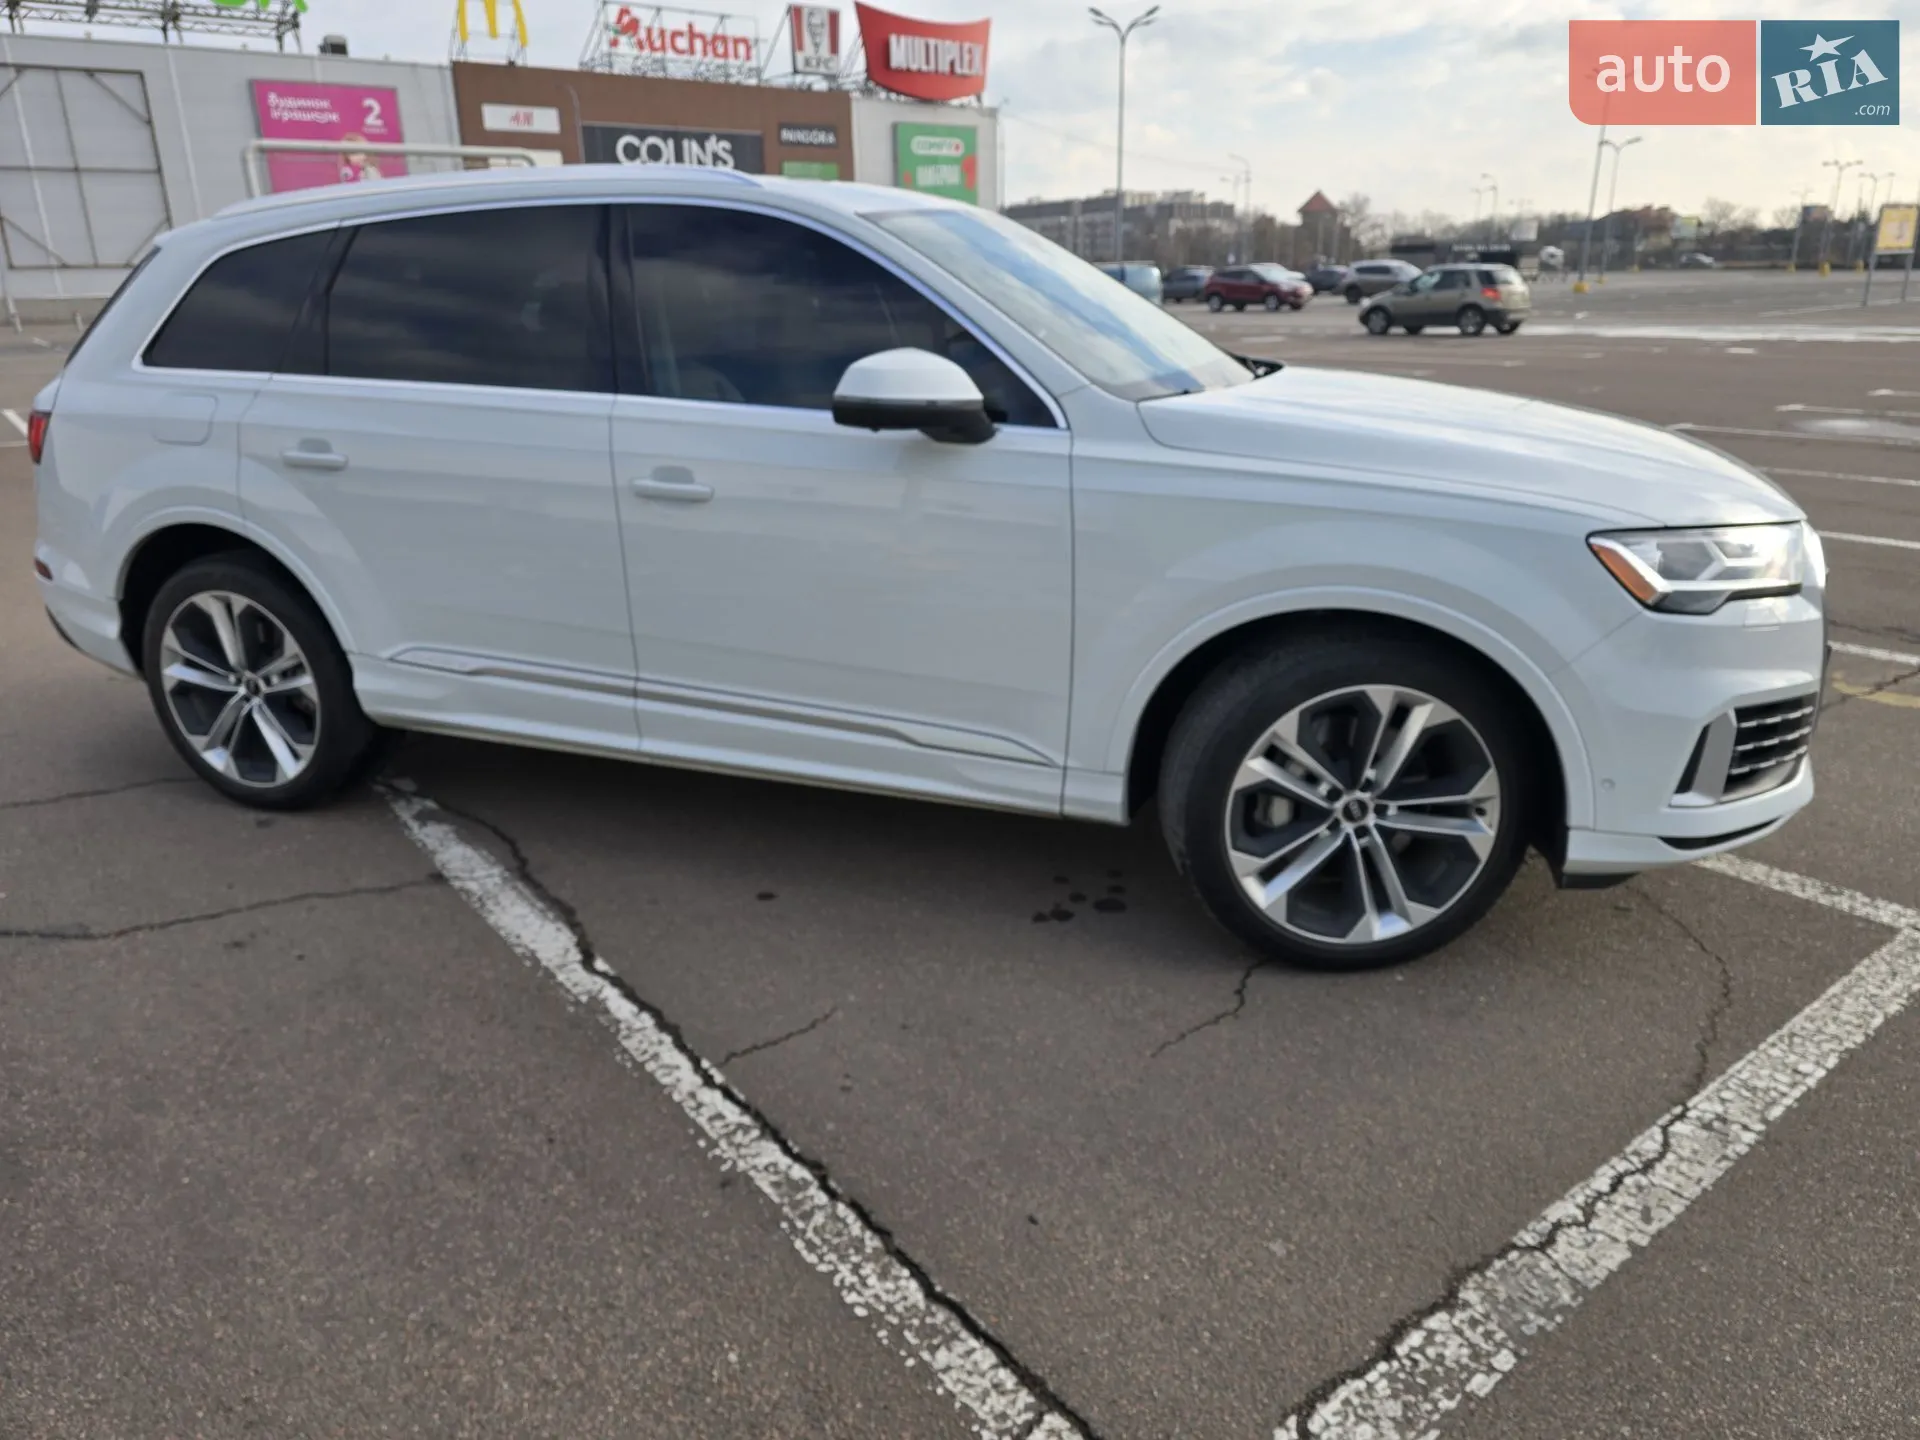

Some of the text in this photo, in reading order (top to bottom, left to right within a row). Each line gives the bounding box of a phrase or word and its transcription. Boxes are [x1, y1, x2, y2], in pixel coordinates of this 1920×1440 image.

[609, 5, 752, 62] Auchan
[888, 33, 983, 76] MULTIPLEX
[363, 97, 385, 126] 2
[615, 133, 735, 169] COLIN'S
